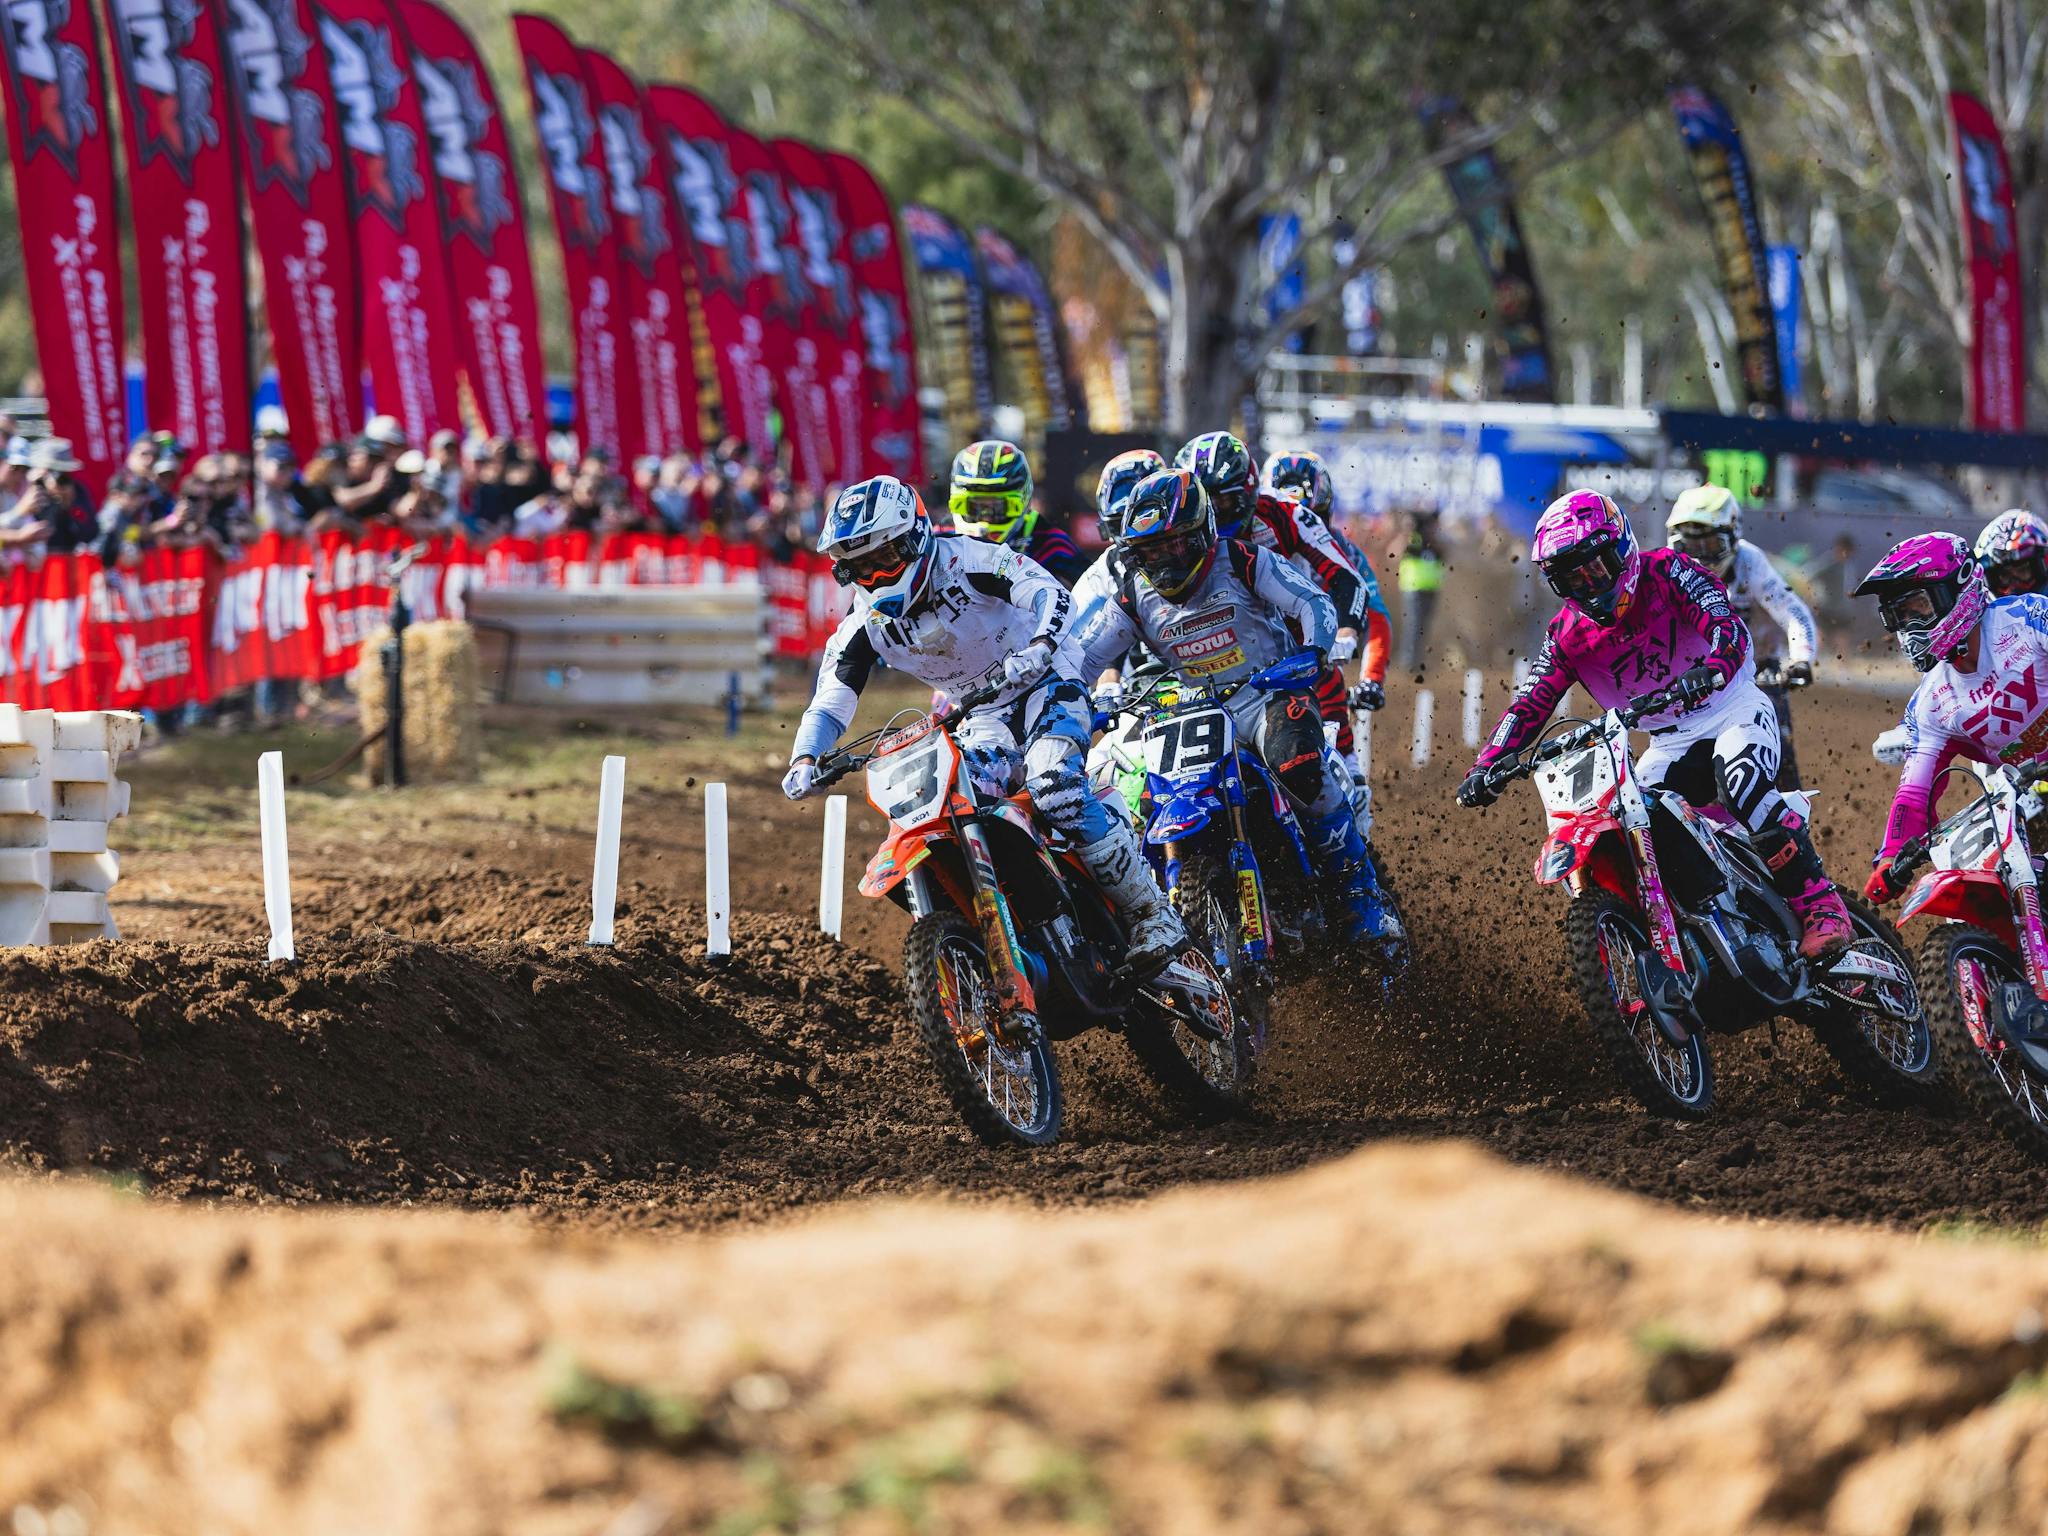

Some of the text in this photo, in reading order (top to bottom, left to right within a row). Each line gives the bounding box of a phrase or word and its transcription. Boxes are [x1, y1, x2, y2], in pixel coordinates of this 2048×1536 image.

[1177, 632, 1234, 656] MOTUL
[1145, 713, 1225, 775] 79
[889, 748, 938, 819] 3
[1564, 749, 1596, 803] 1
